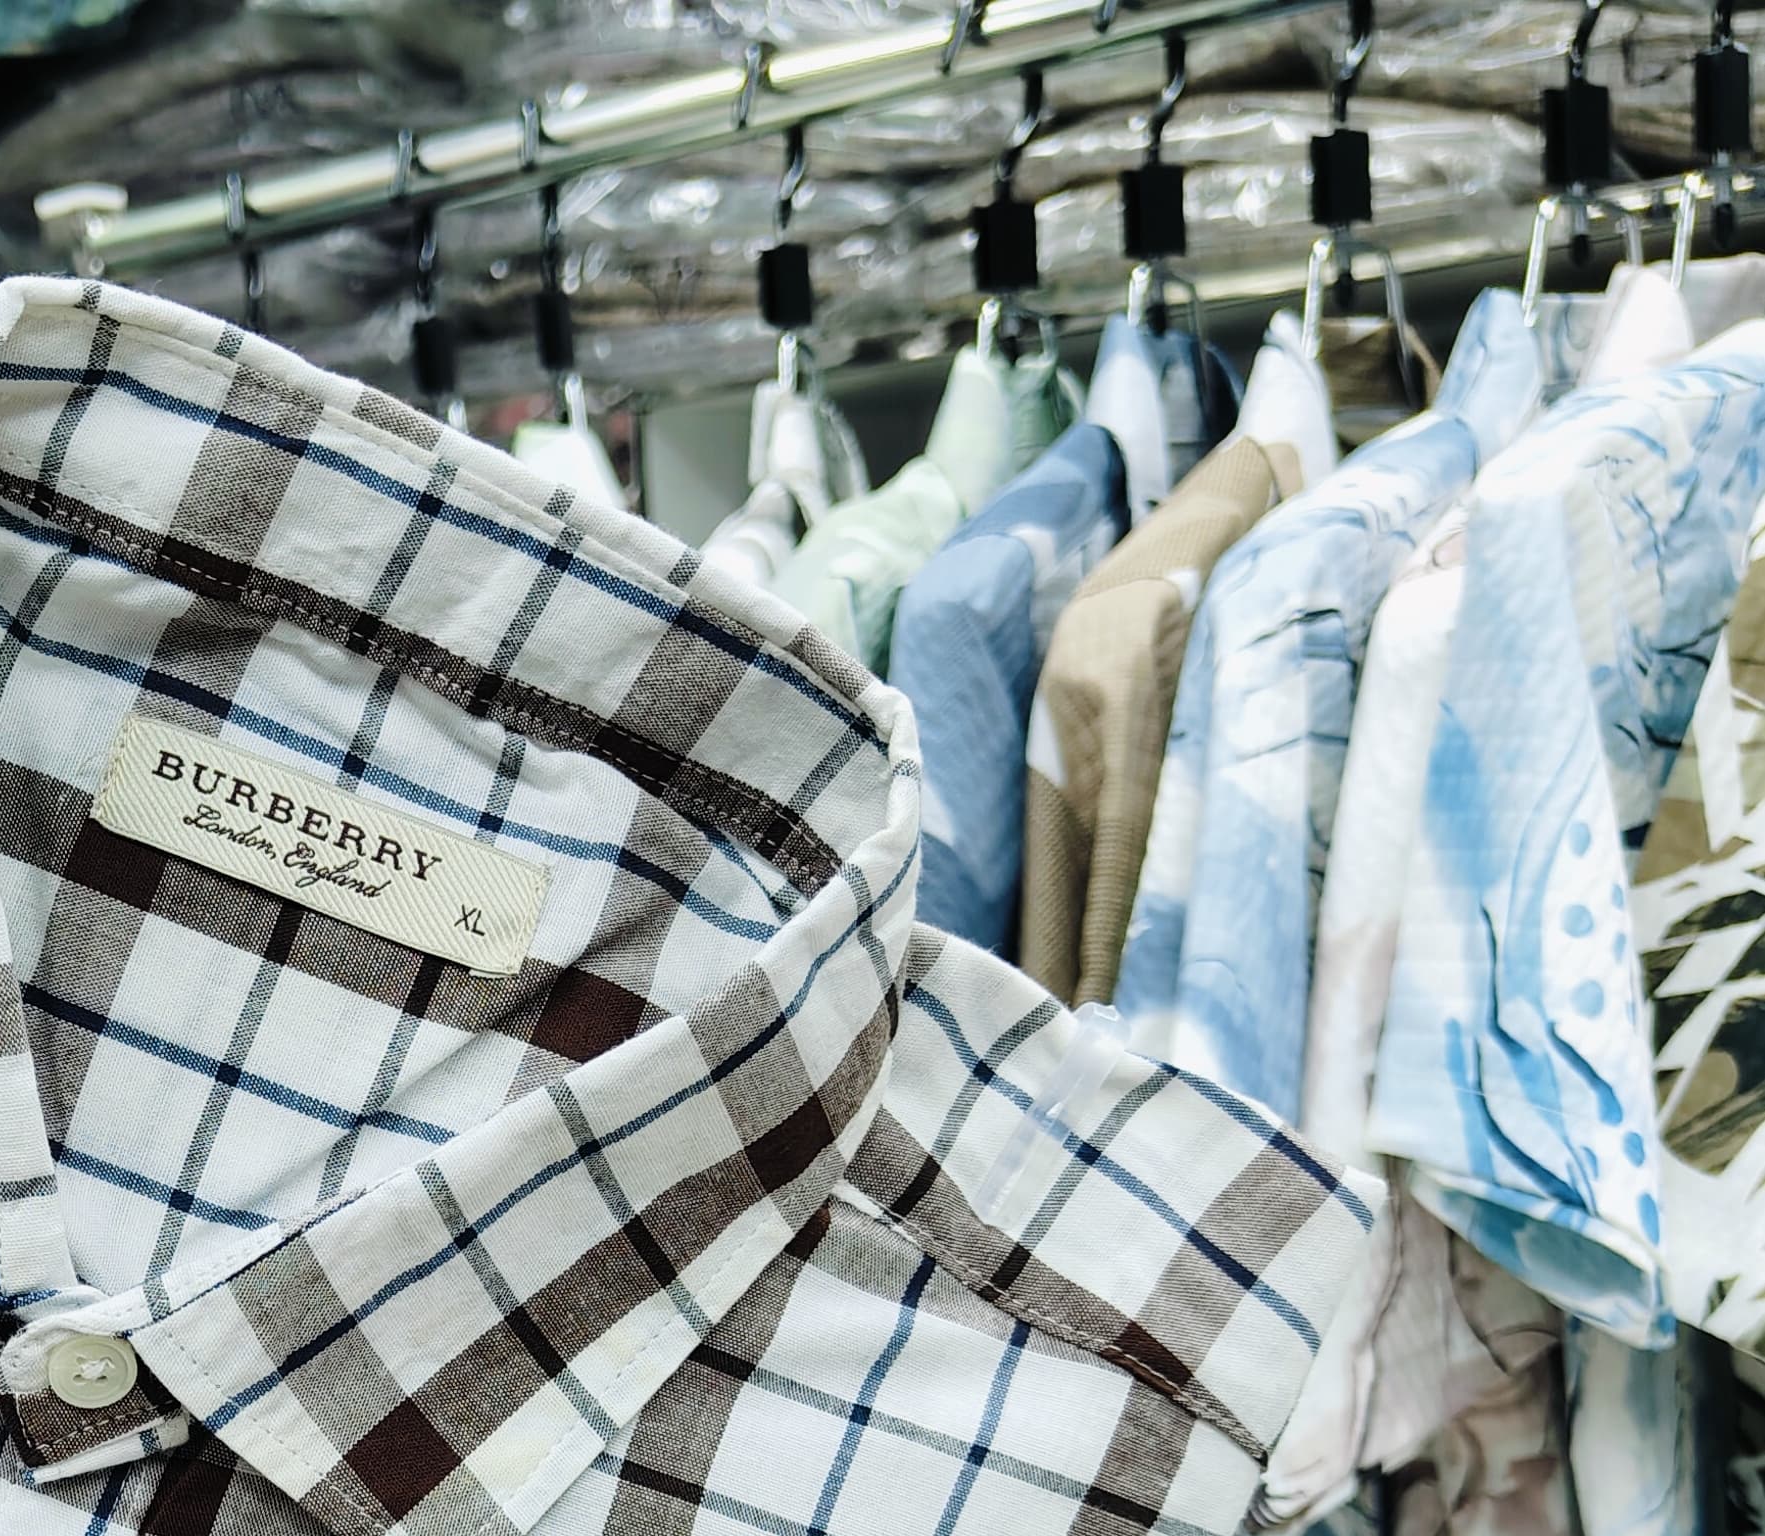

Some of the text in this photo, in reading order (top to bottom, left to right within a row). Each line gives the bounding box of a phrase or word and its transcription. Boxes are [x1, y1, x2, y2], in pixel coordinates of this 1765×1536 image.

[153, 751, 442, 880] BURBERRY
[183, 804, 392, 898] London, England
[454, 904, 486, 936] XL
